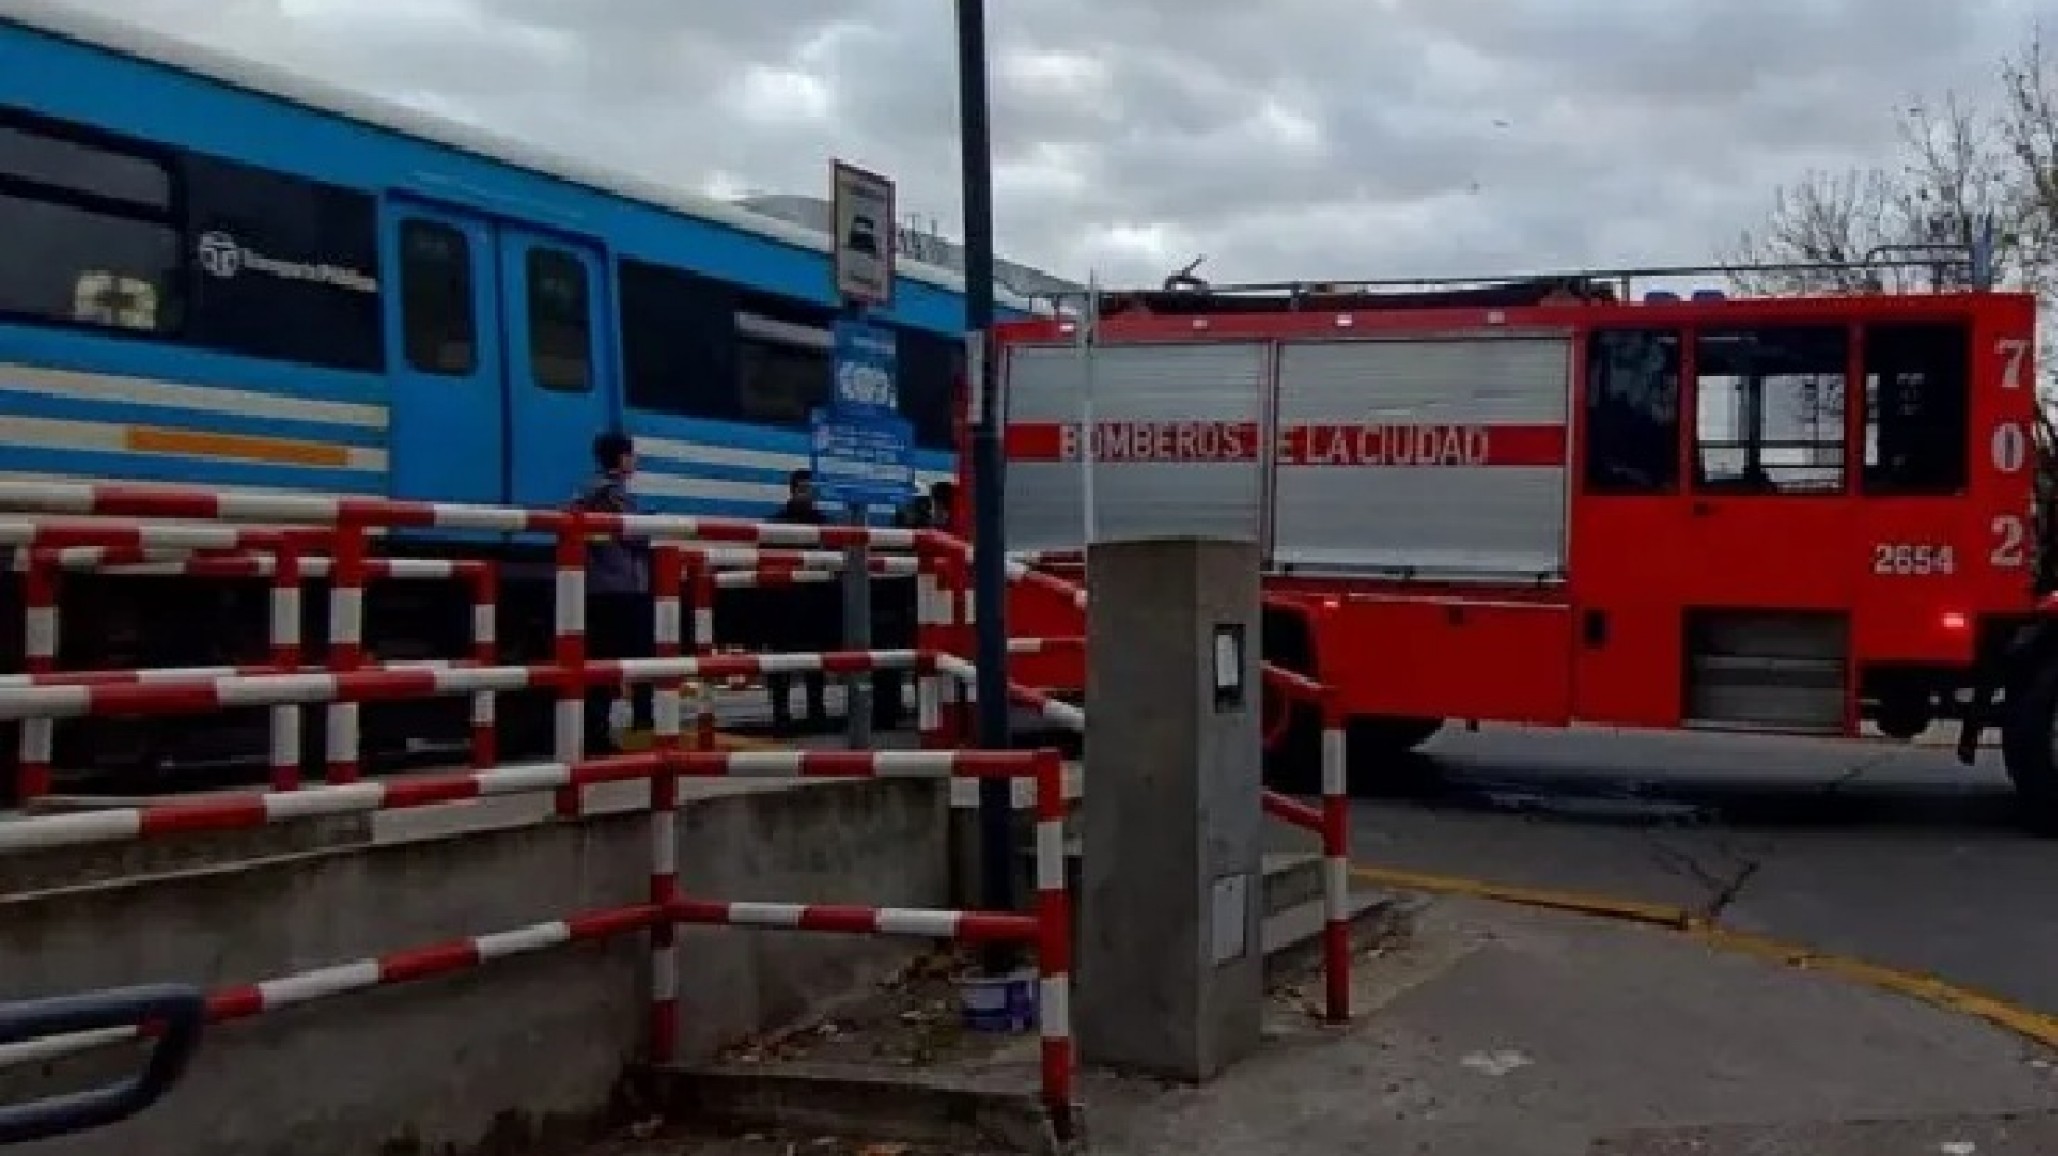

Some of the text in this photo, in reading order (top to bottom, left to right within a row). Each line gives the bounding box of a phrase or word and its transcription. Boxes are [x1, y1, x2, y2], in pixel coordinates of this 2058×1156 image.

[1061, 422, 1242, 459] BOMBEROS
[1306, 424, 1350, 464] LA
[1356, 424, 1489, 465] CIUDAD
[1874, 545, 1955, 574] 2654
